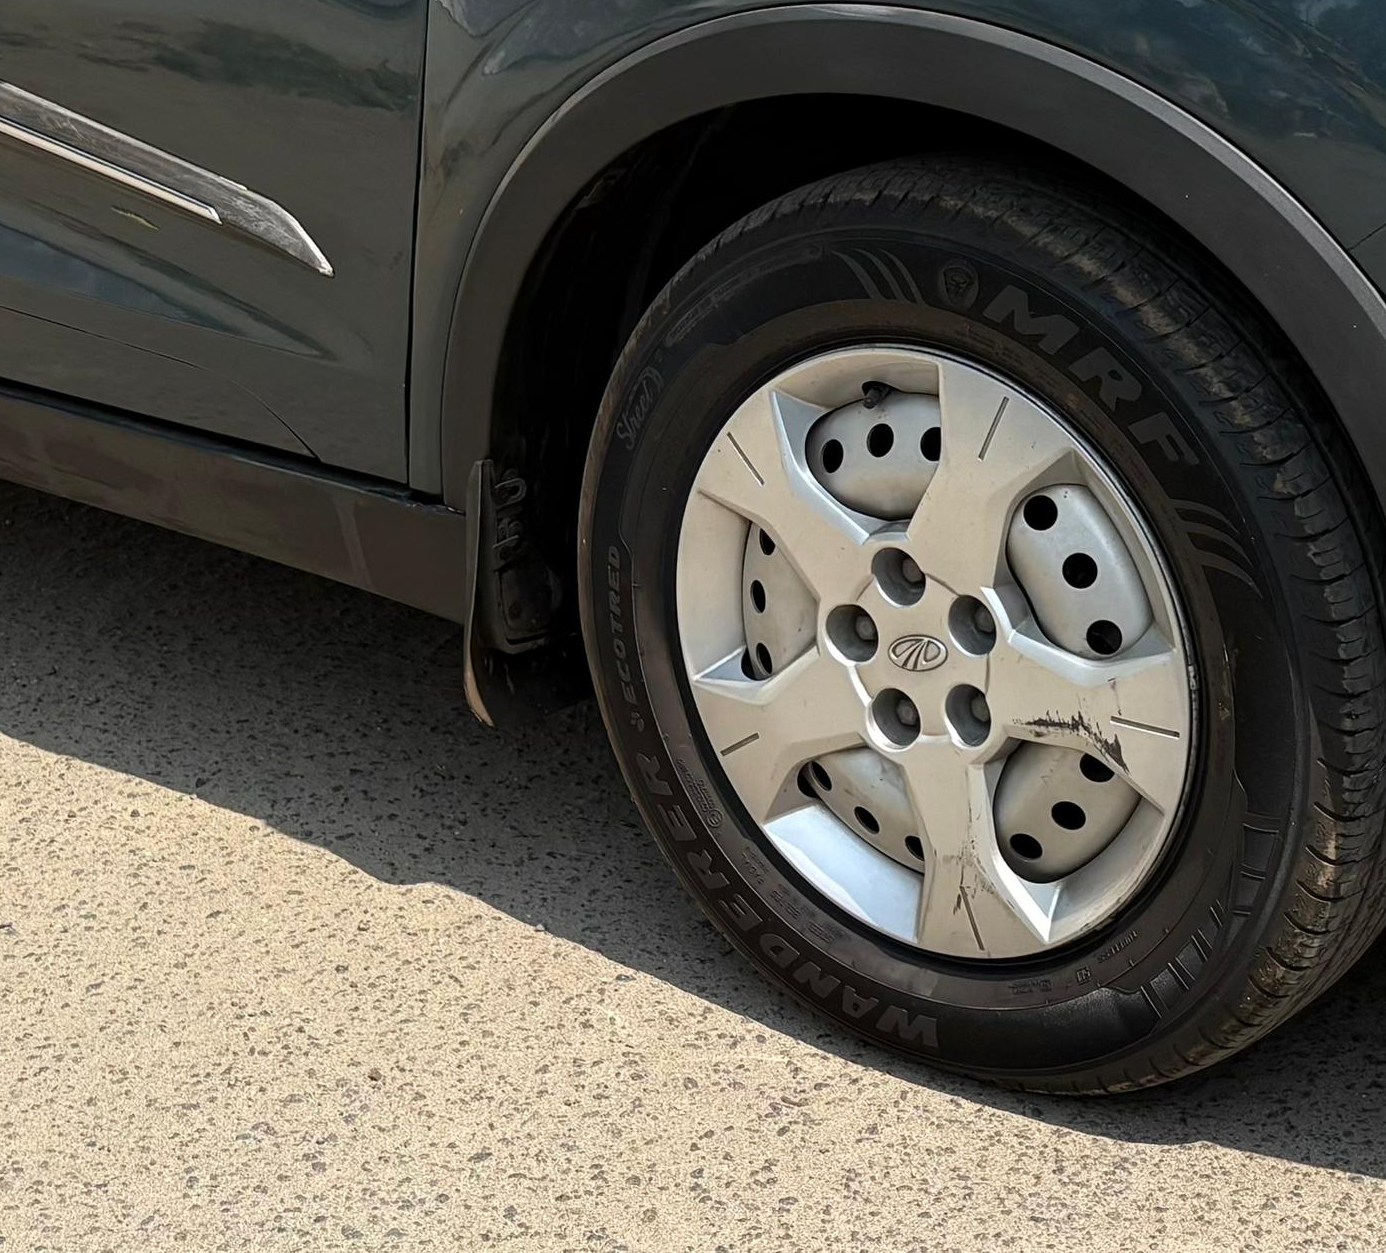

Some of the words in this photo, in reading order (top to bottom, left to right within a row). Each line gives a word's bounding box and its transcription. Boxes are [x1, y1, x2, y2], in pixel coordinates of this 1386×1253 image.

[983, 284, 1199, 466] MRF
[606, 545, 636, 707] ECOTRED
[636, 751, 941, 1048] WANDERER
